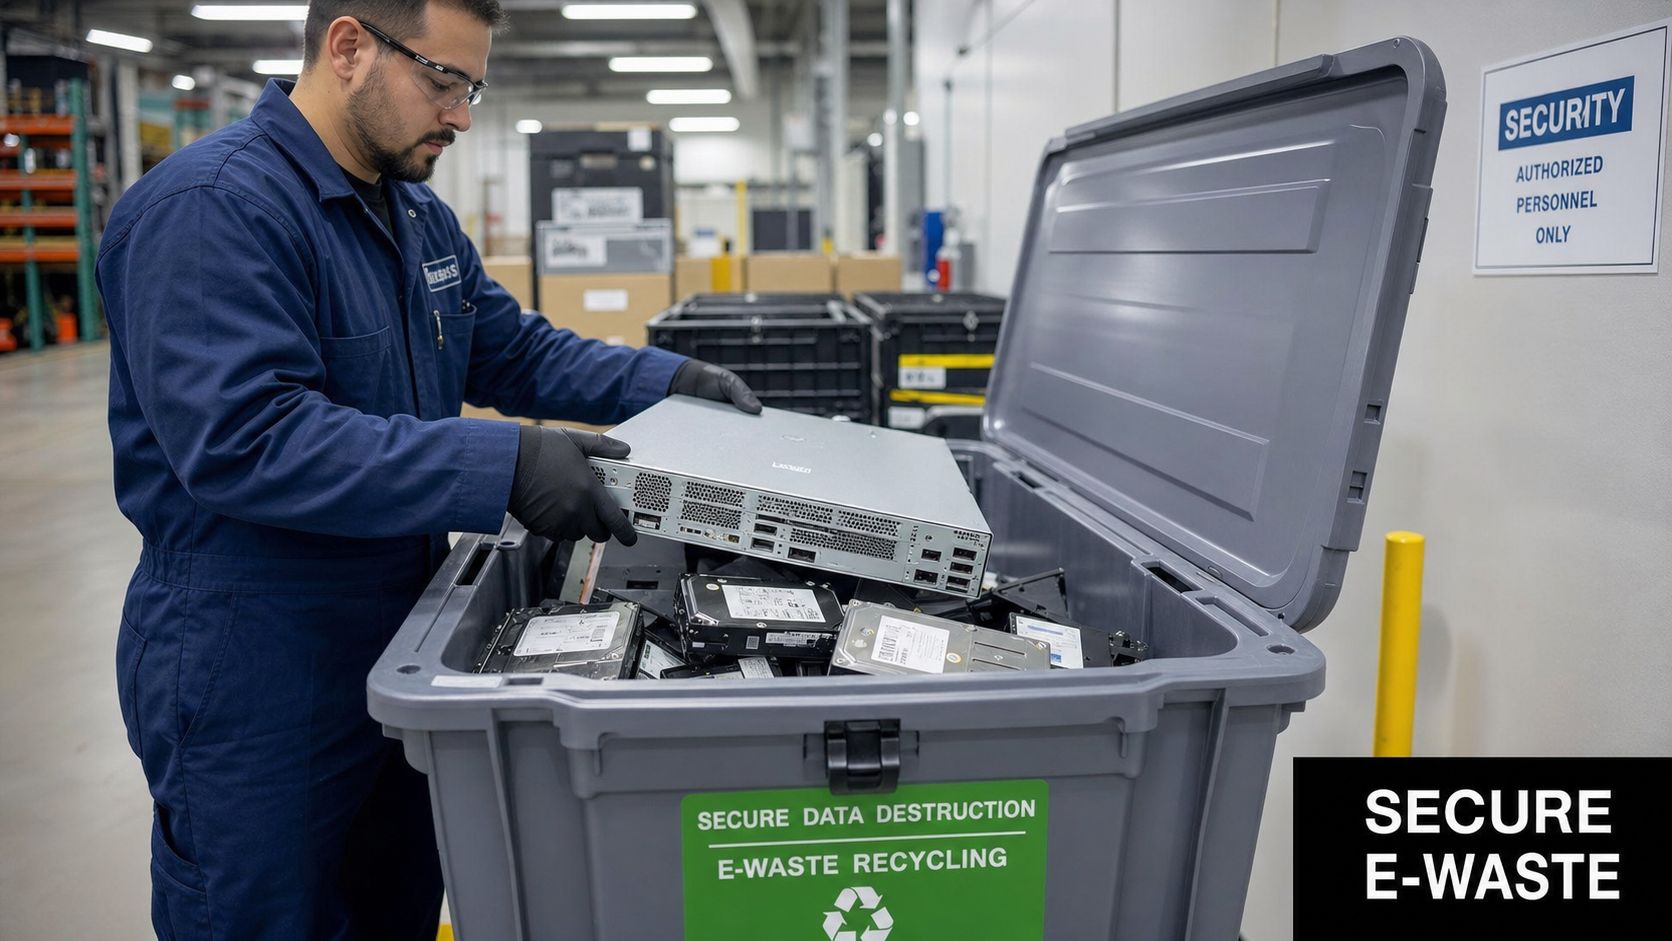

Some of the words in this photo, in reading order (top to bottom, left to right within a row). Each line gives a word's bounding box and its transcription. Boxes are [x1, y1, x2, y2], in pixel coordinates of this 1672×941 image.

[1505, 88, 1626, 142] SECURITY
[1516, 156, 1604, 183] AUTHORIZED
[1516, 190, 1598, 214] PERSONNEL
[1536, 225, 1571, 245] ONLY
[698, 809, 789, 831] SECURE
[803, 806, 864, 826] DATA
[877, 799, 1036, 823] DESTRUCTION
[718, 854, 839, 880] E-WASTE
[853, 847, 1008, 874] RECYCLING
